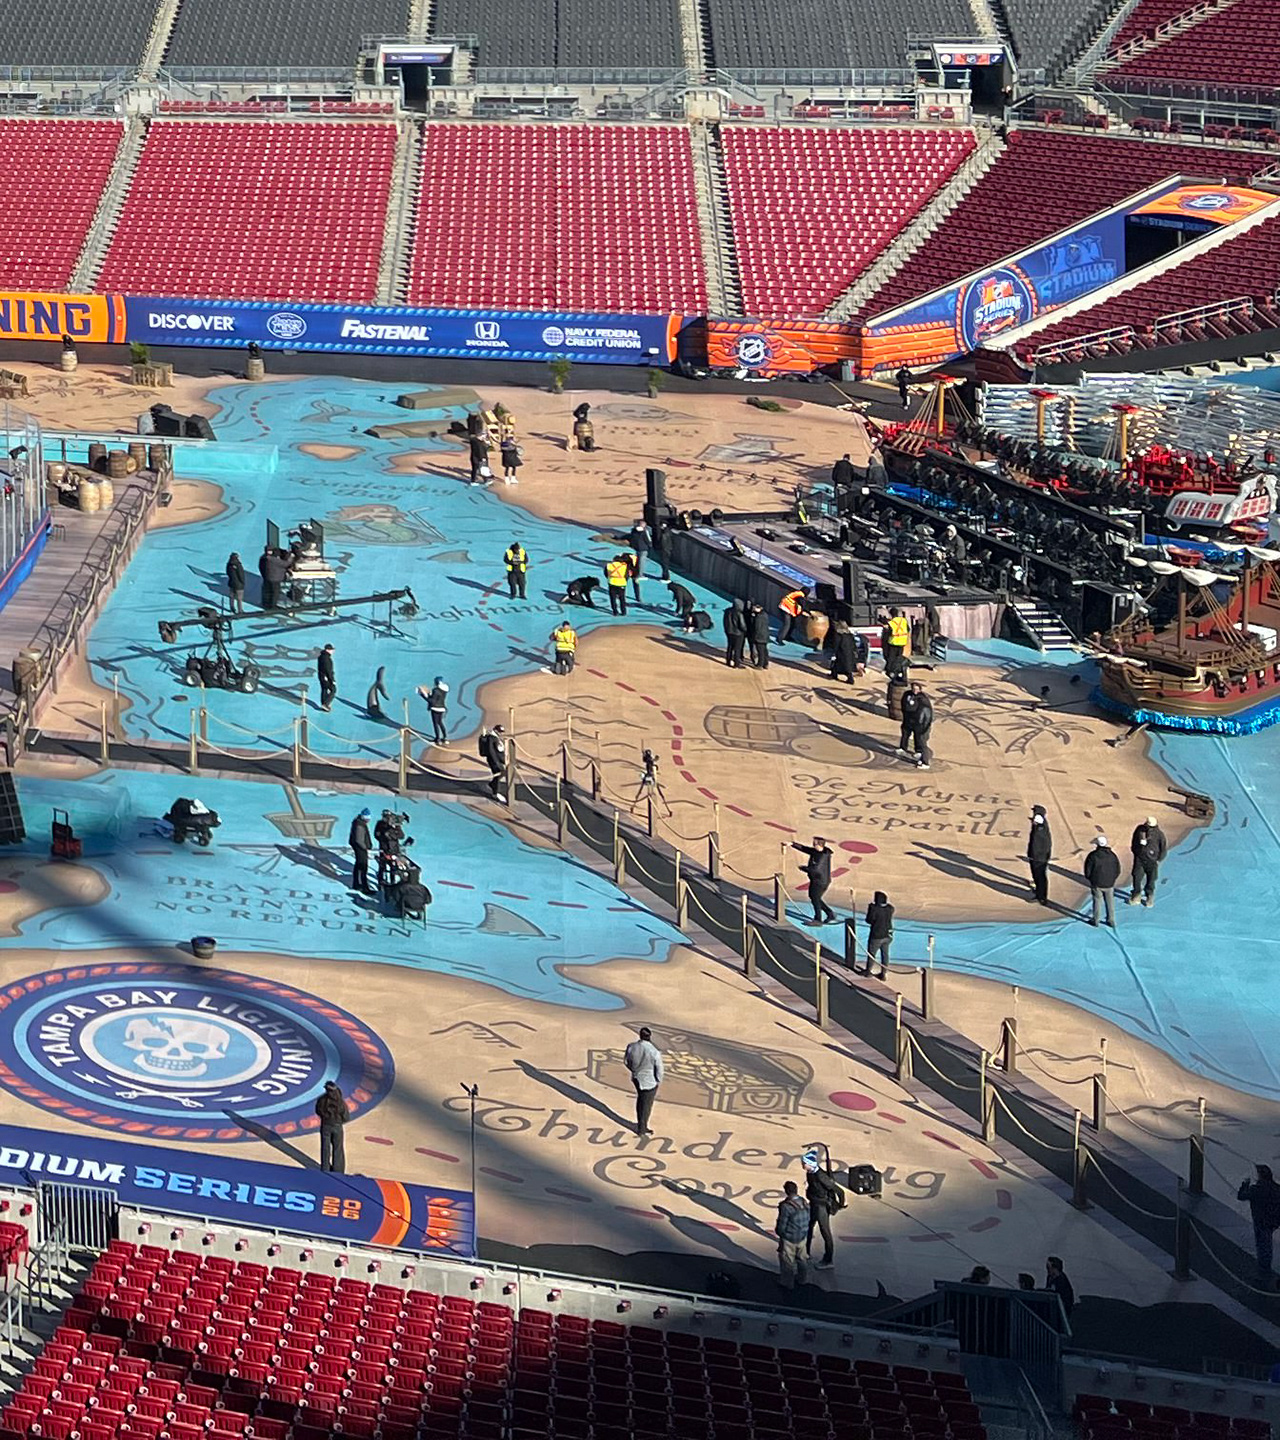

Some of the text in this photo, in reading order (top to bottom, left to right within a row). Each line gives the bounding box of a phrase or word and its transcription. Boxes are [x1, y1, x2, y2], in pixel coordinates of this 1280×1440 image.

[149, 313, 236, 332] DISCOVER
[975, 296, 1024, 323] STADIUM
[341, 319, 431, 340] FASTENAL
[564, 327, 640, 338] NAVY FEDERAL
[565, 339, 641, 349] CREDIT UNION
[789, 773, 1022, 808] Ye Mystic
[806, 789, 1015, 828] Krewe of
[809, 806, 1022, 840] Gasparilla
[165, 875, 344, 905] BRAYDE
[184, 890, 319, 915] POINT
[154, 900, 413, 938] NO RETURN
[40, 990, 314, 1098] TAMPA BAY LIGHTNING
[134, 1164, 318, 1214] SERIES
[592, 1152, 809, 1209] Cove
[322, 1208, 360, 1220] 26
[324, 1196, 362, 1208] 20
